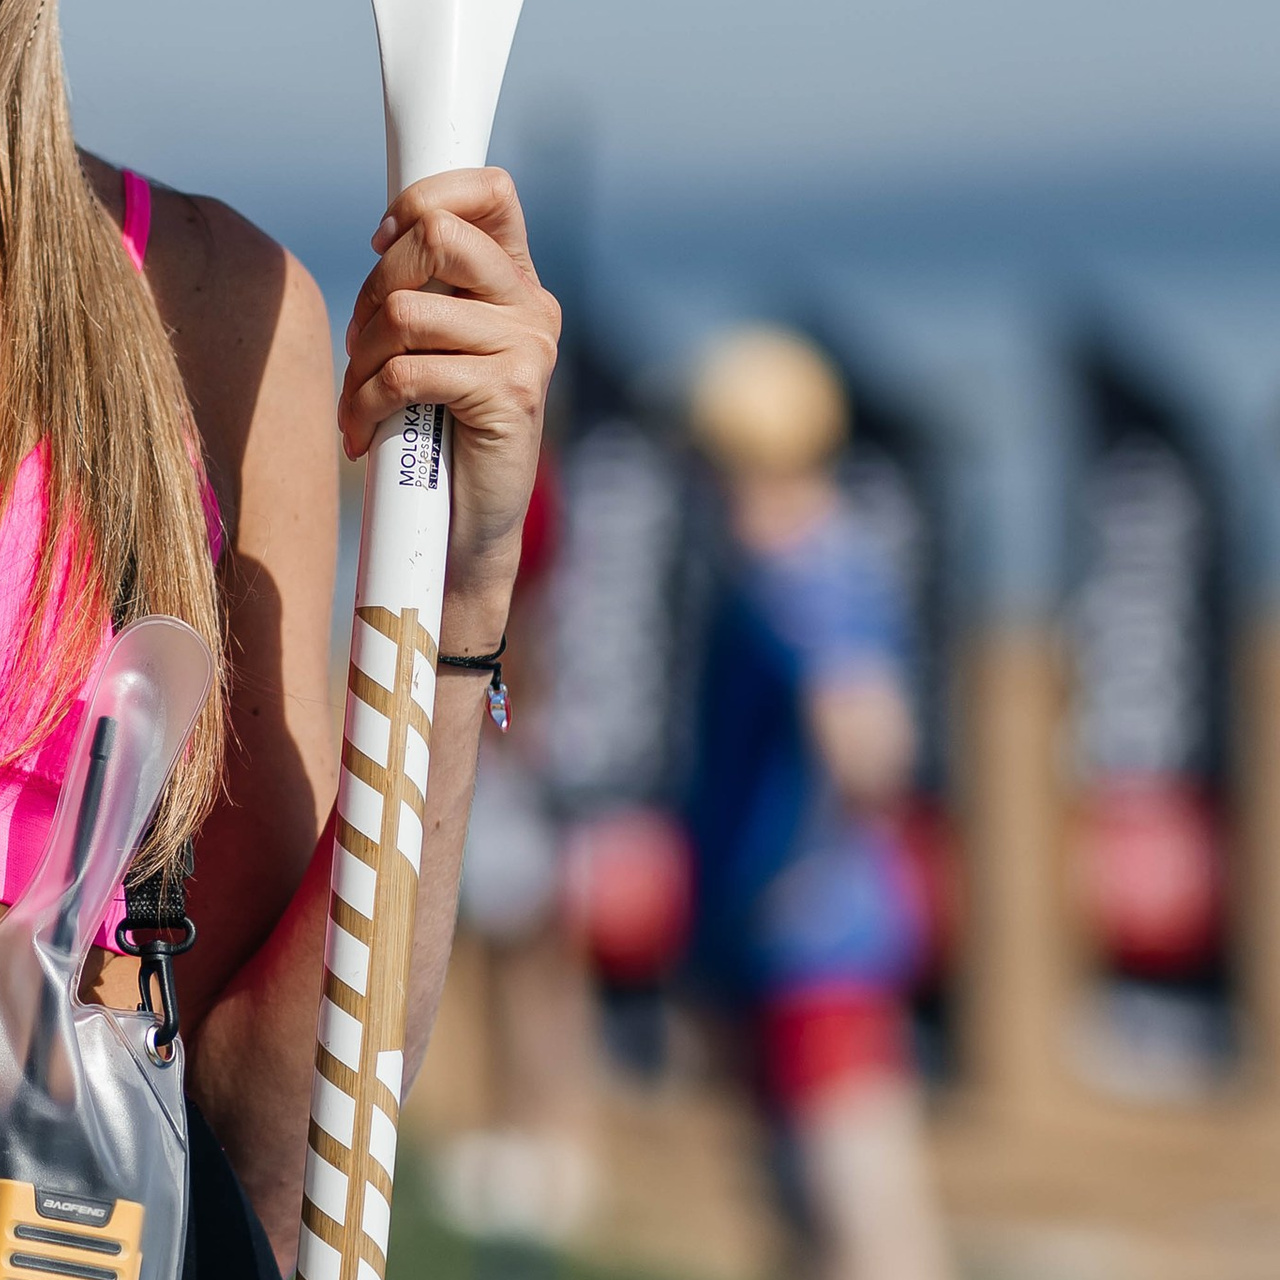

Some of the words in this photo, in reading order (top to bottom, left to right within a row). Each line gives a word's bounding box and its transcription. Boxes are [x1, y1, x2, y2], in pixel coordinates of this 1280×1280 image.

[399, 404, 421, 486] MOLOKA
[415, 404, 433, 487] Professiona
[43, 1199, 106, 1218] BAOFENG
